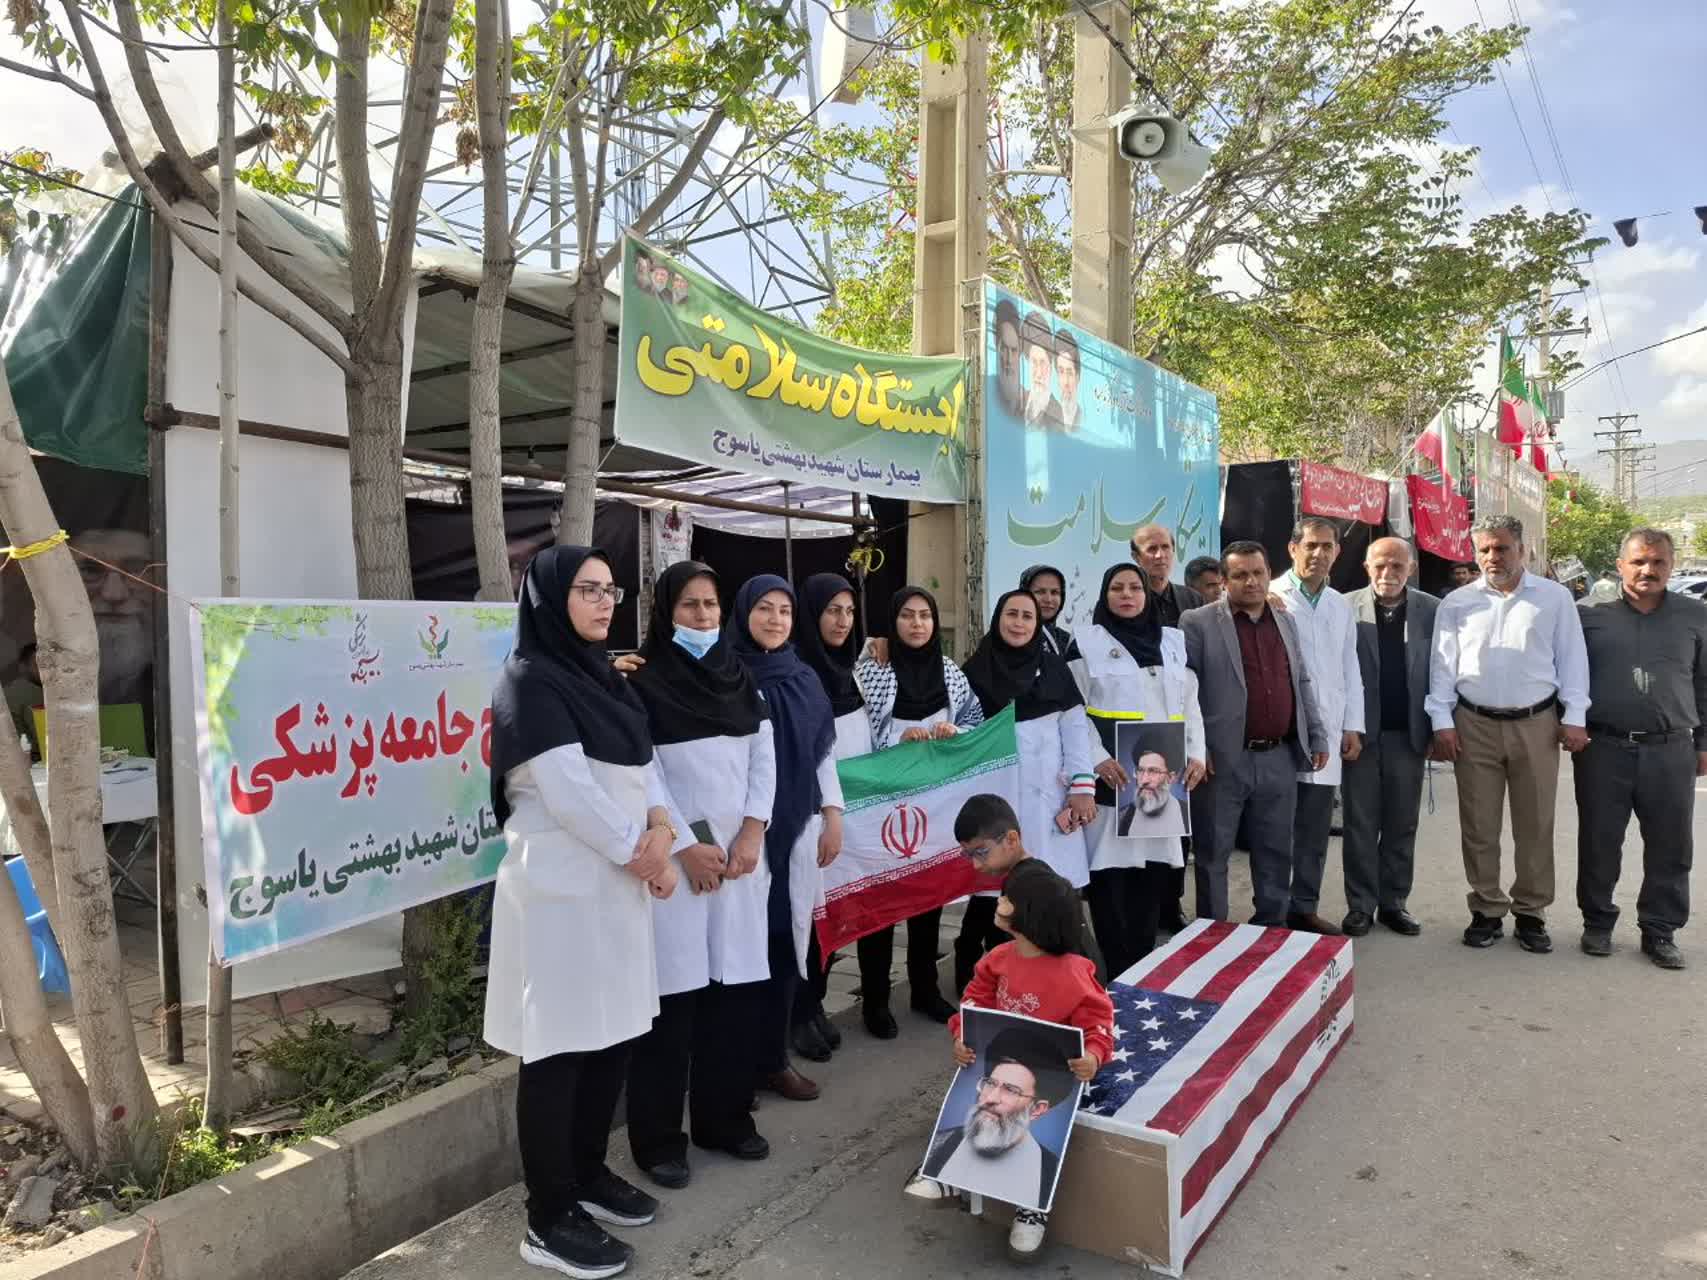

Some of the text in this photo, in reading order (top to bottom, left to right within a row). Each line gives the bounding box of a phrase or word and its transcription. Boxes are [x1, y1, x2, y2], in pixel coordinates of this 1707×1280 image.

[636, 313, 834, 413] سلامتی
[713, 429, 761, 462] یاسوج
[762, 441, 808, 472] بهشتی
[807, 454, 845, 477] شهید
[230, 702, 378, 816] پزشکی
[380, 690, 475, 773] جامعه
[323, 833, 402, 894] بهشتی
[405, 815, 458, 866] شهید
[229, 848, 319, 919] یاسوج
